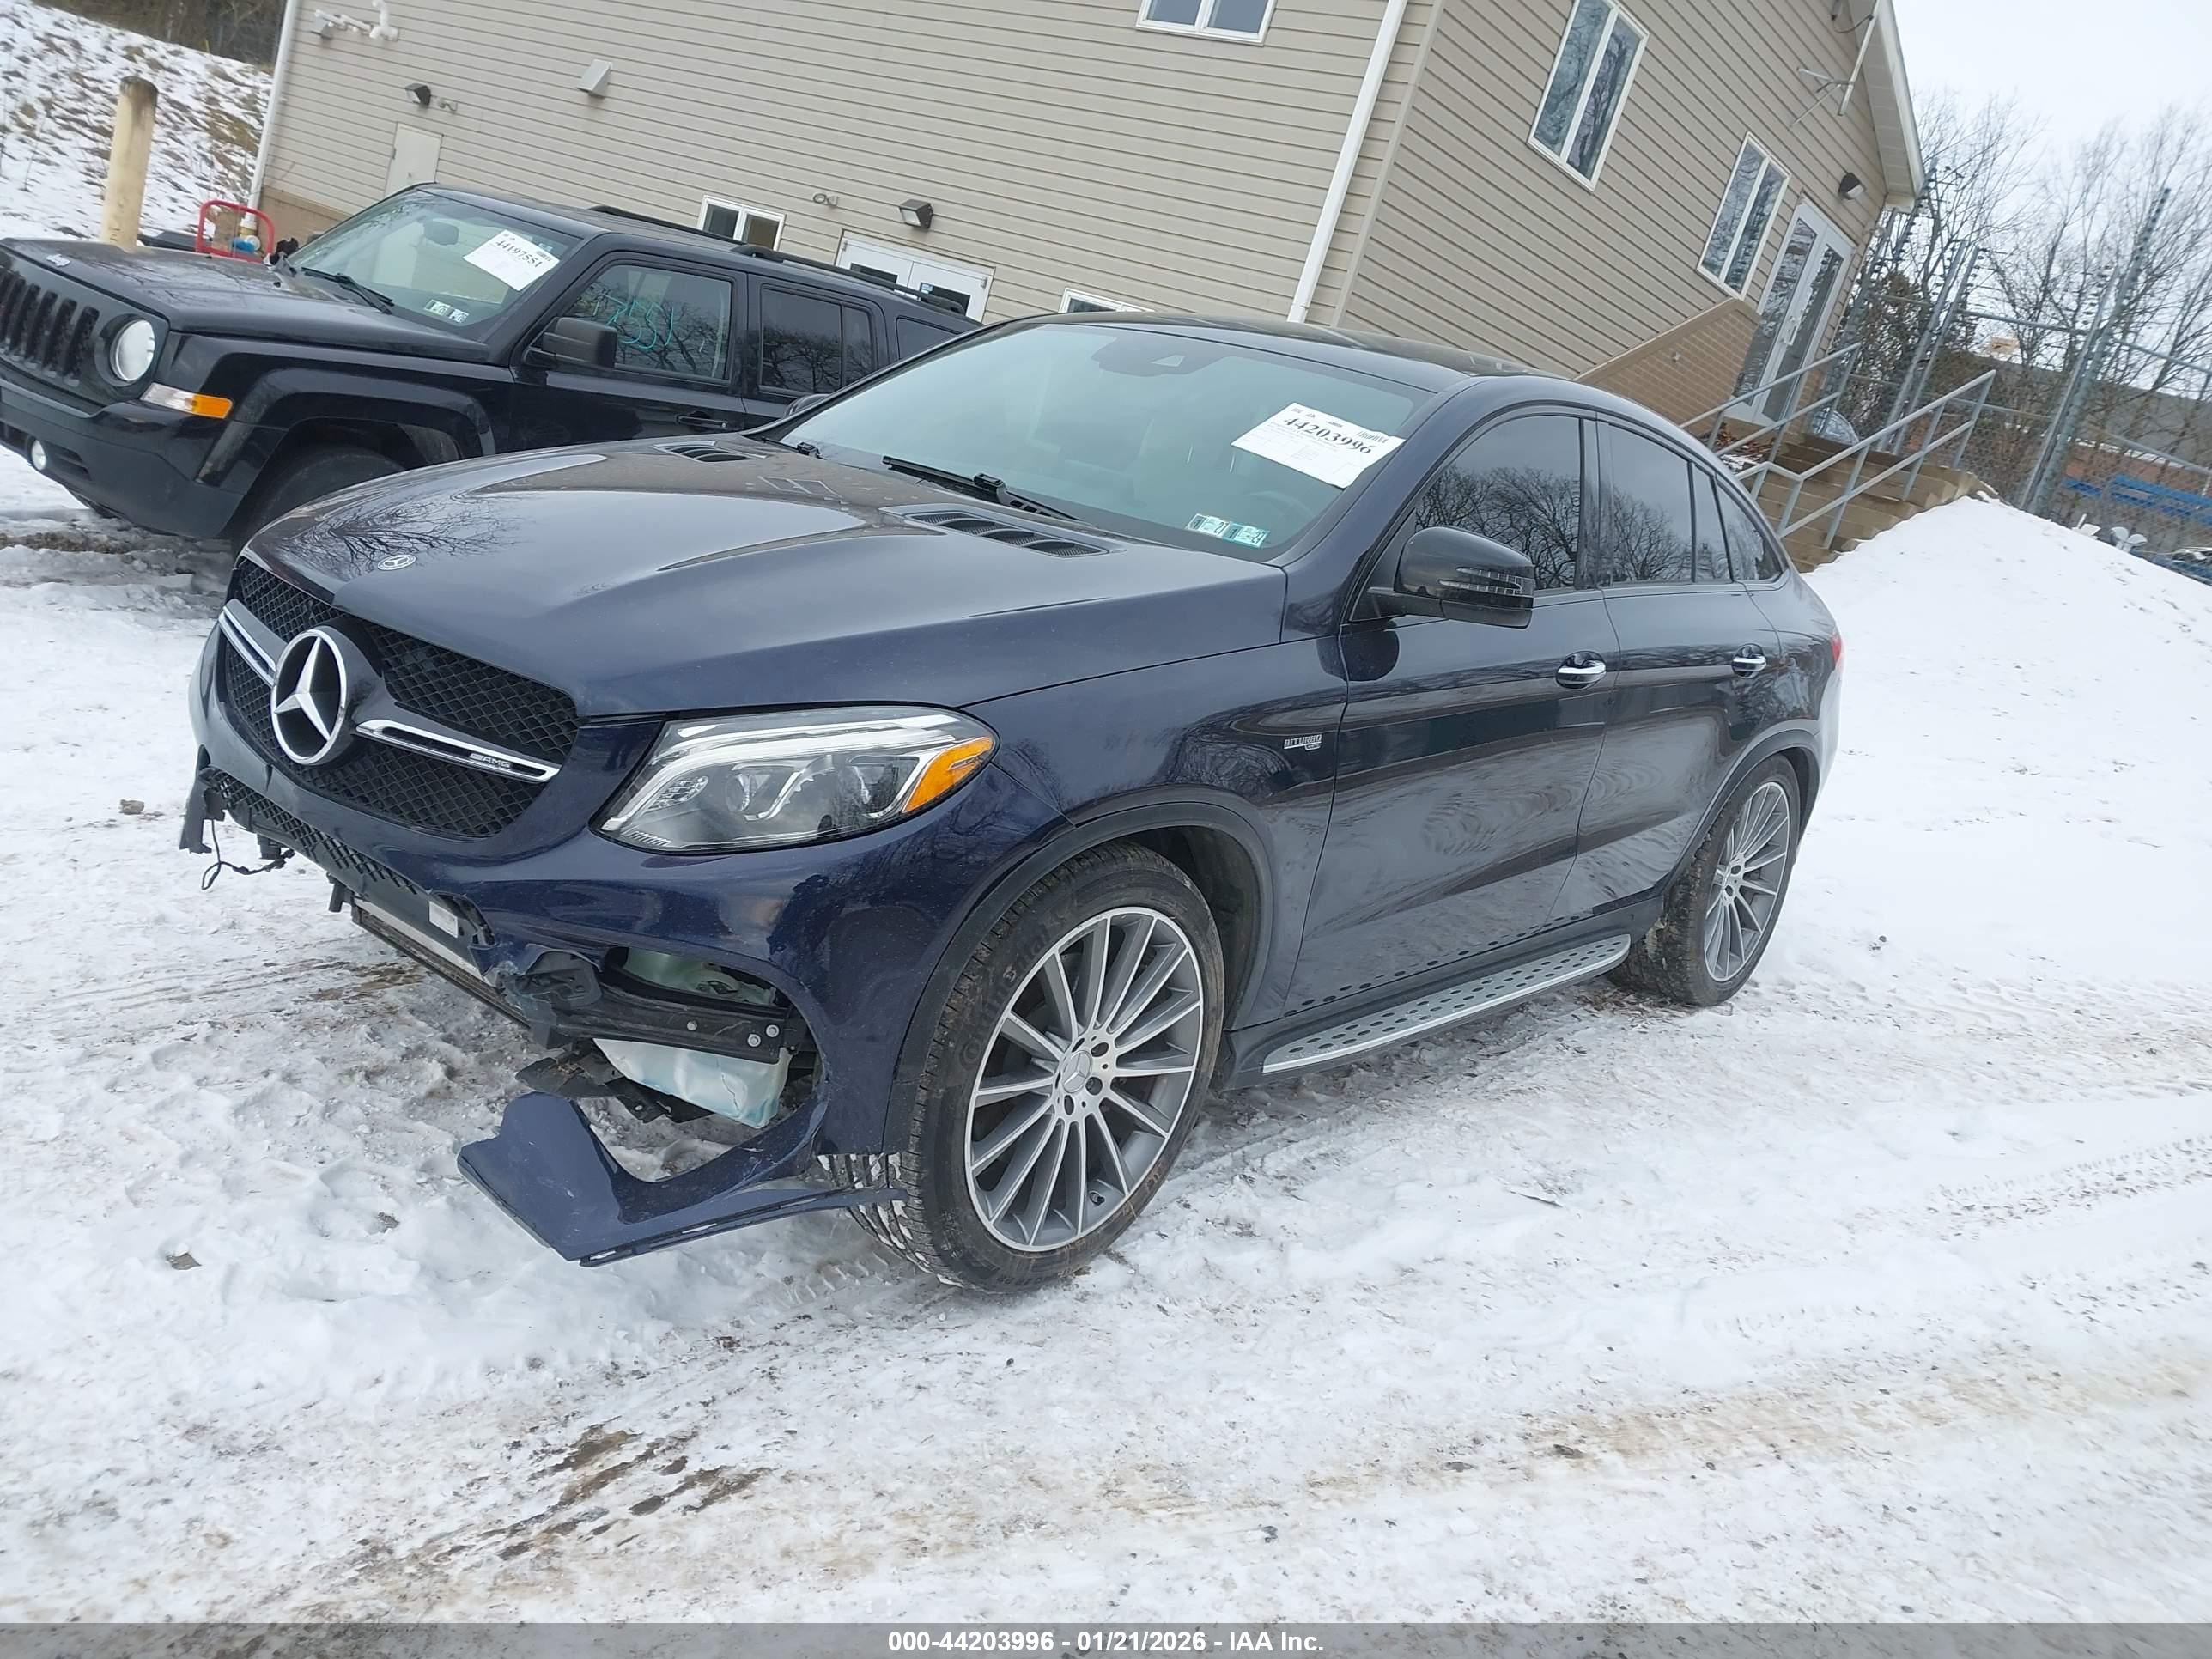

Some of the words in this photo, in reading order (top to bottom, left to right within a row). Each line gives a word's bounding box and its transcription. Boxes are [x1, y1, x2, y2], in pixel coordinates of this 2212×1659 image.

[495, 240, 543, 268] 44197551
[1284, 417, 1376, 453] 44203996
[482, 757, 511, 768] AMG
